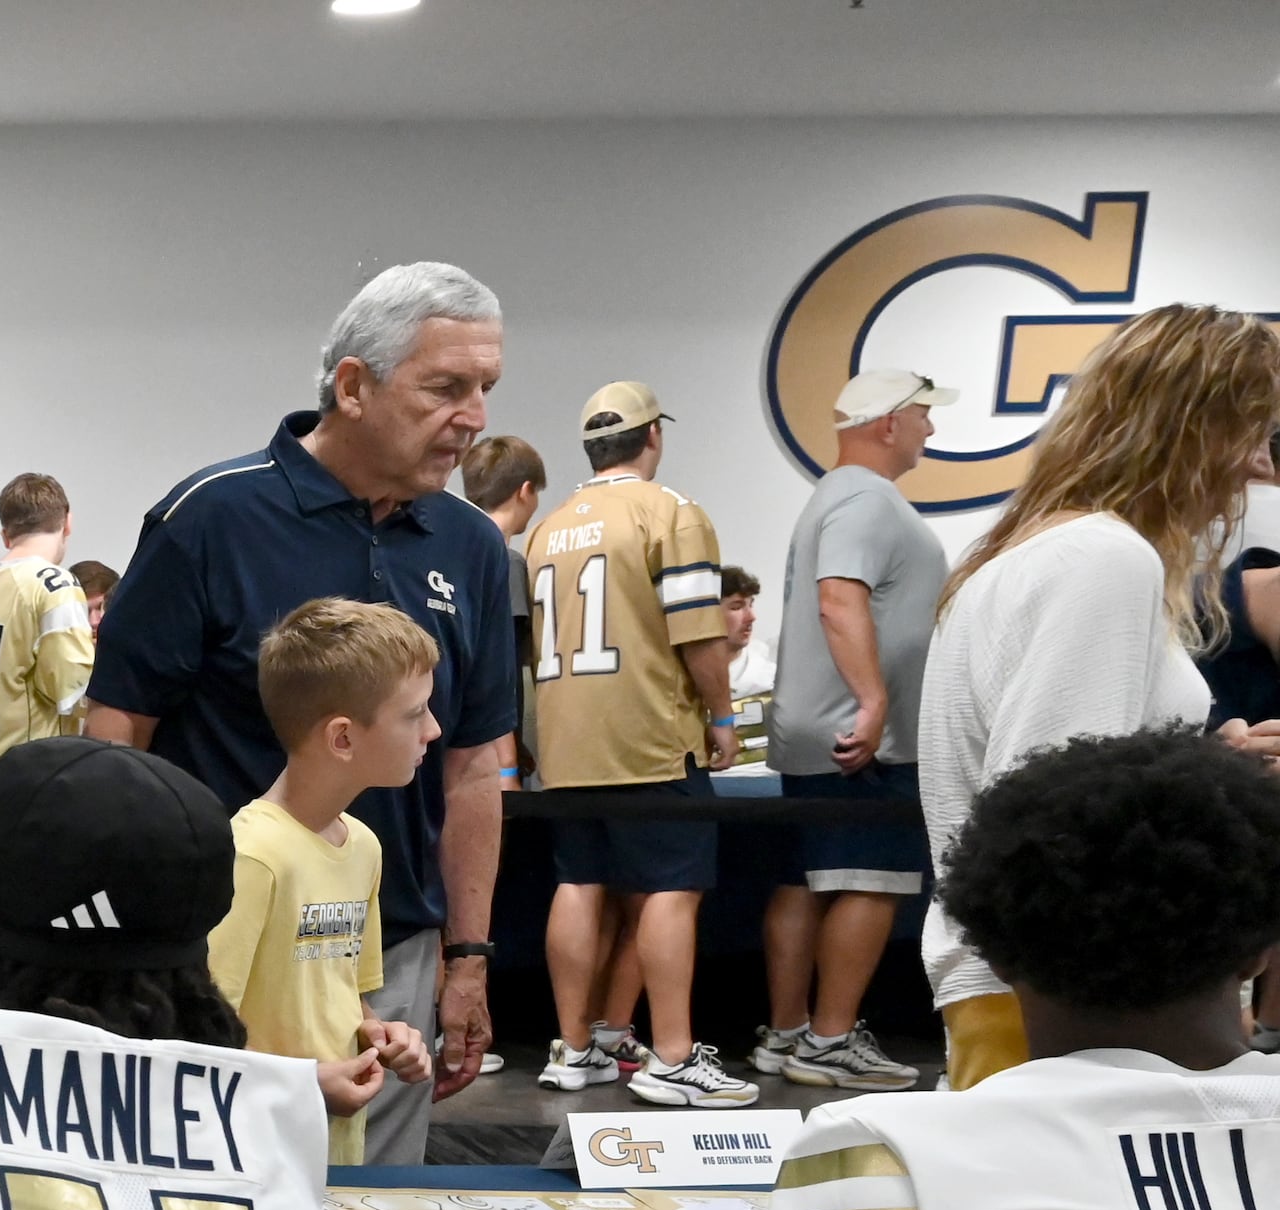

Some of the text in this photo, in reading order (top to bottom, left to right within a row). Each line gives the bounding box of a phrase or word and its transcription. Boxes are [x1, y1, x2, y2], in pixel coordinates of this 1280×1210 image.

[766, 190, 1280, 513] G
[546, 521, 604, 555] HAYNES
[534, 554, 620, 682] 11
[589, 1127, 665, 1173] GT
[693, 1133, 771, 1150] KELVIN HILL
[702, 1155, 773, 1165] #16 DEFENSIVE BACK
